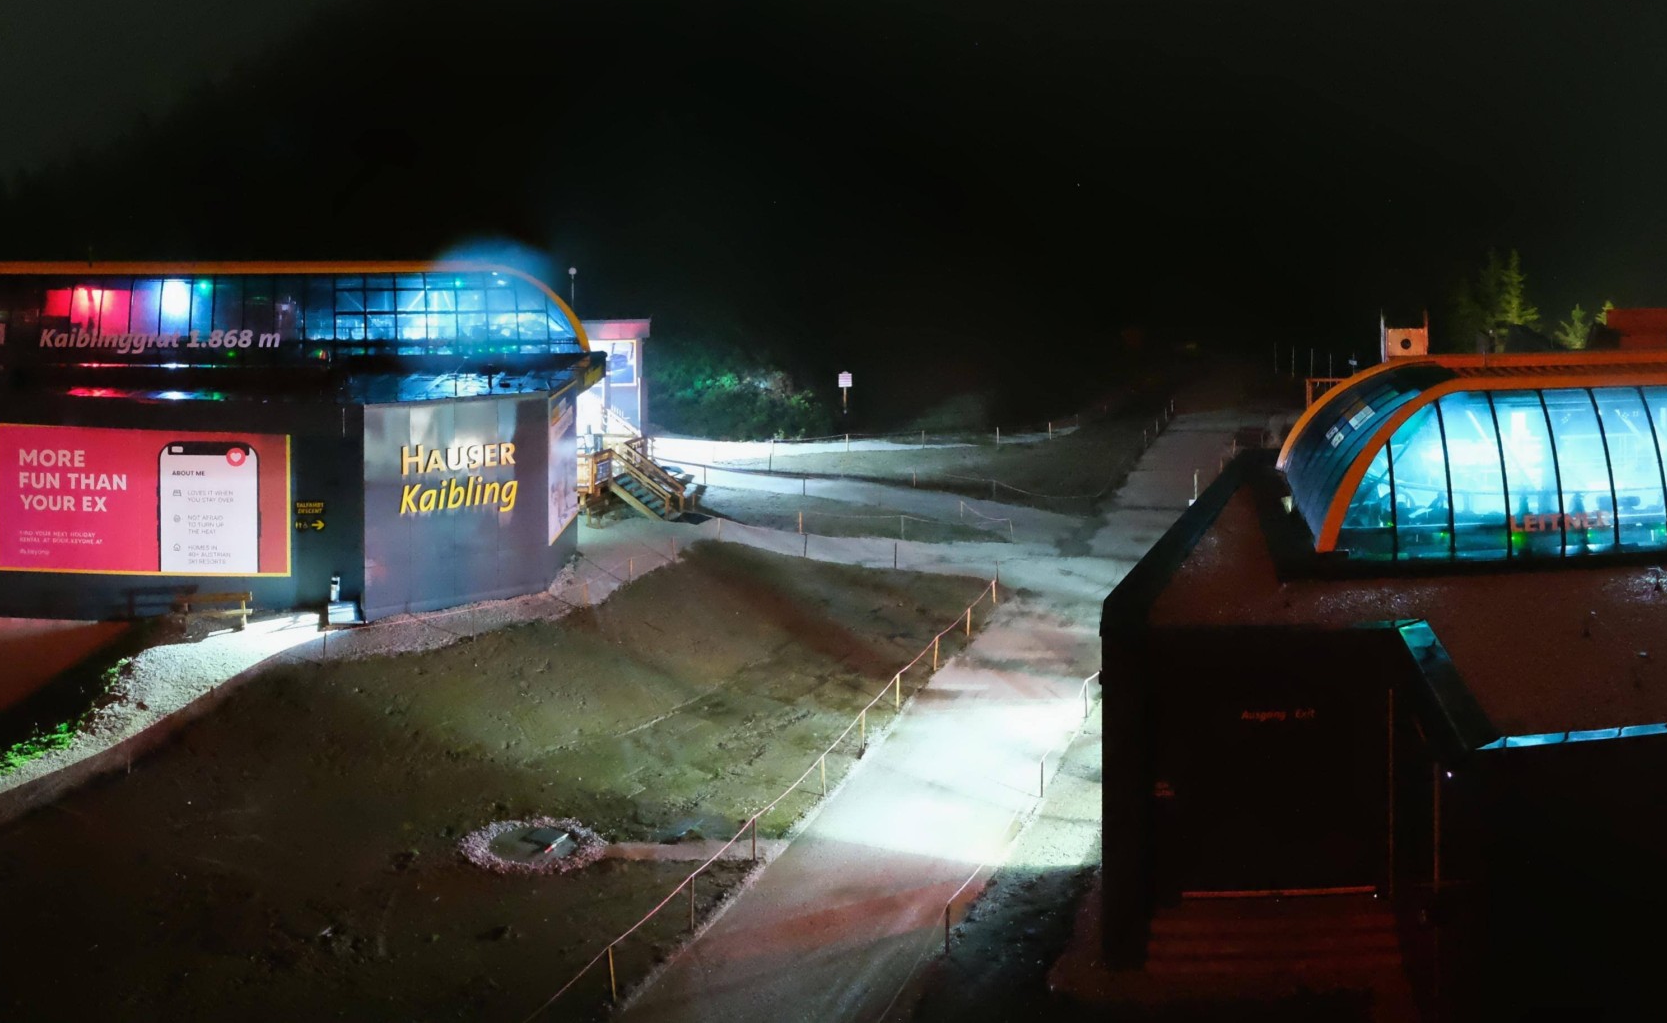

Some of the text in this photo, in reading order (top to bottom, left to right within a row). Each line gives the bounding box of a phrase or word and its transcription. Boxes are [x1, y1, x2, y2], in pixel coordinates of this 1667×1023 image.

[39, 328, 280, 355] Kaiblinggrat 1.868 m
[19, 449, 86, 468] MORE
[400, 442, 516, 476] HAUSER
[19, 472, 127, 491] FUN THAN
[20, 494, 107, 513] YOUR EX
[399, 476, 518, 514] Kaibling
